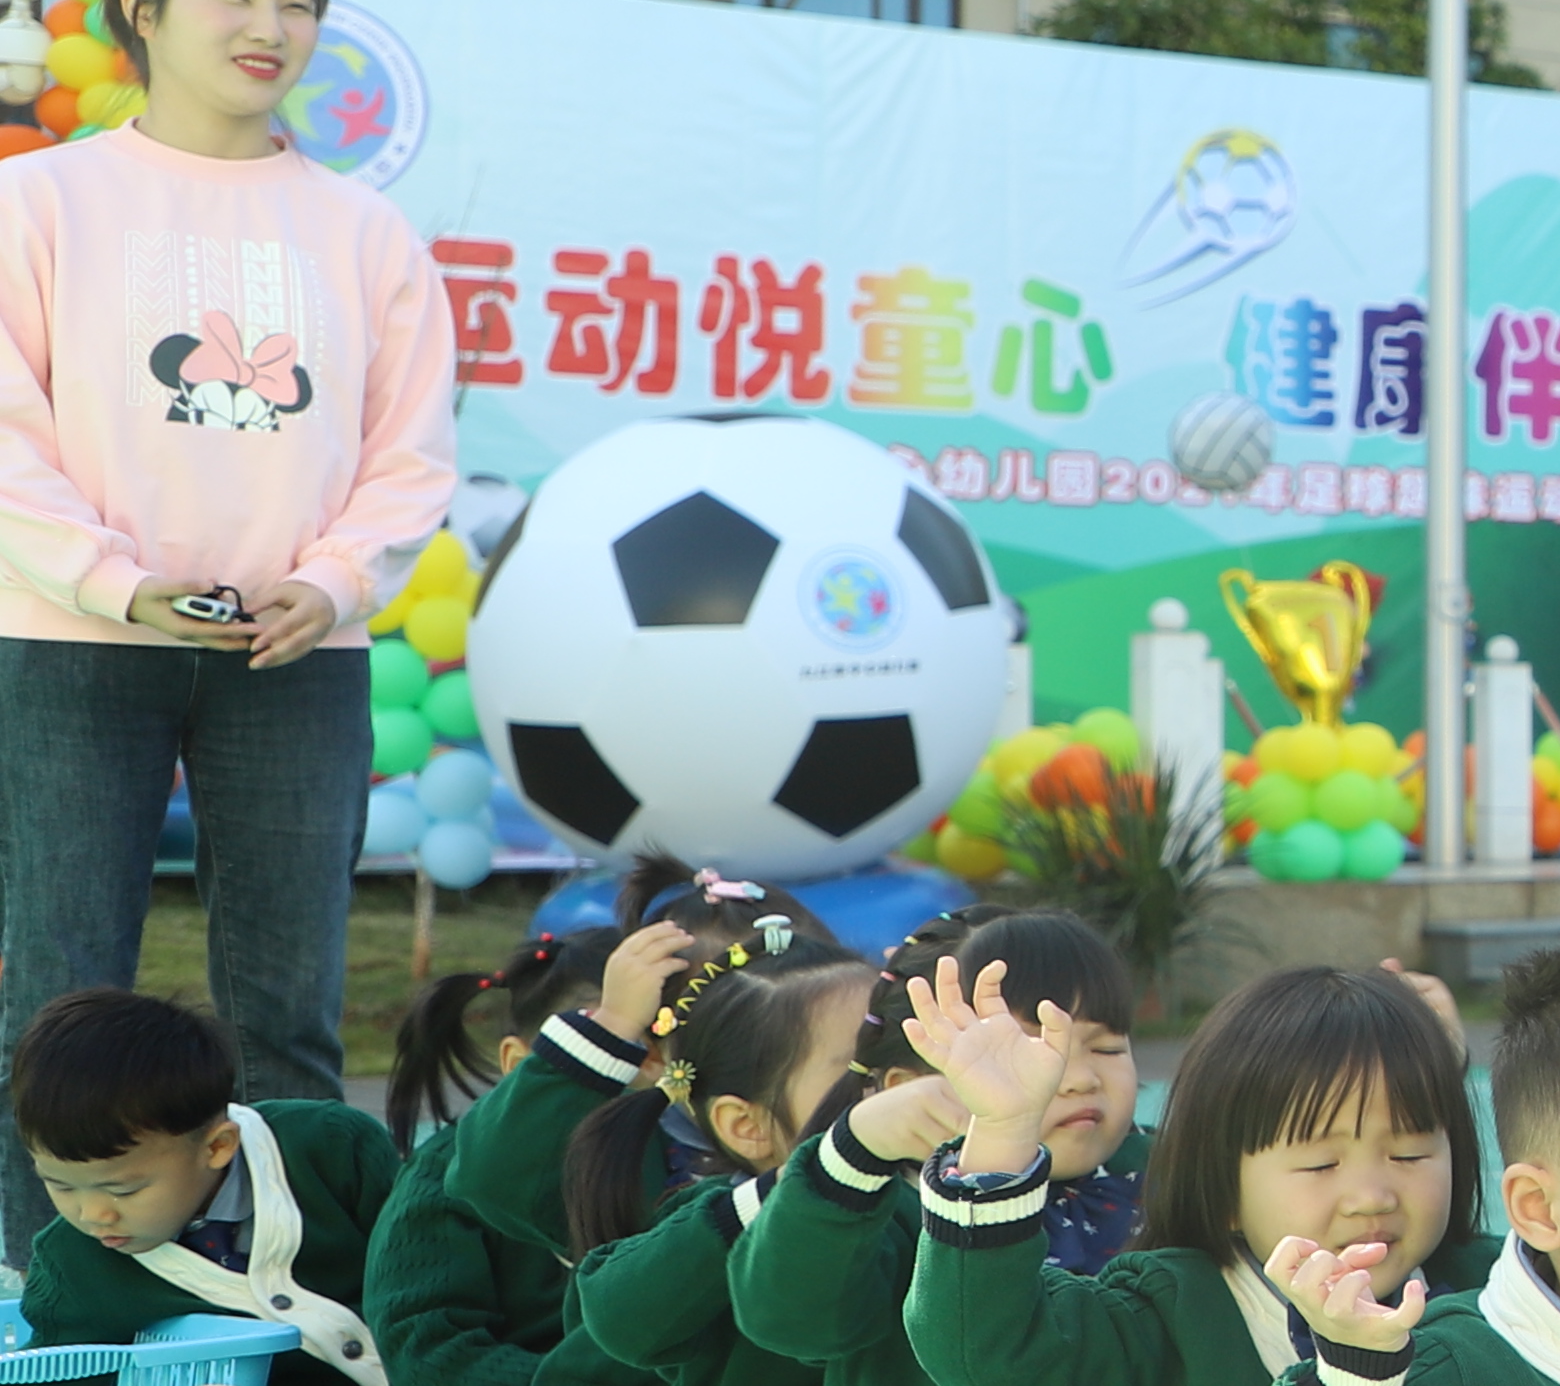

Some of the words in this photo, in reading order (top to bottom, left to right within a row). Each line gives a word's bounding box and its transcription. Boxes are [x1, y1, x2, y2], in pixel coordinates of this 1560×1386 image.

[430, 237, 1113, 414] 运动悦童心
